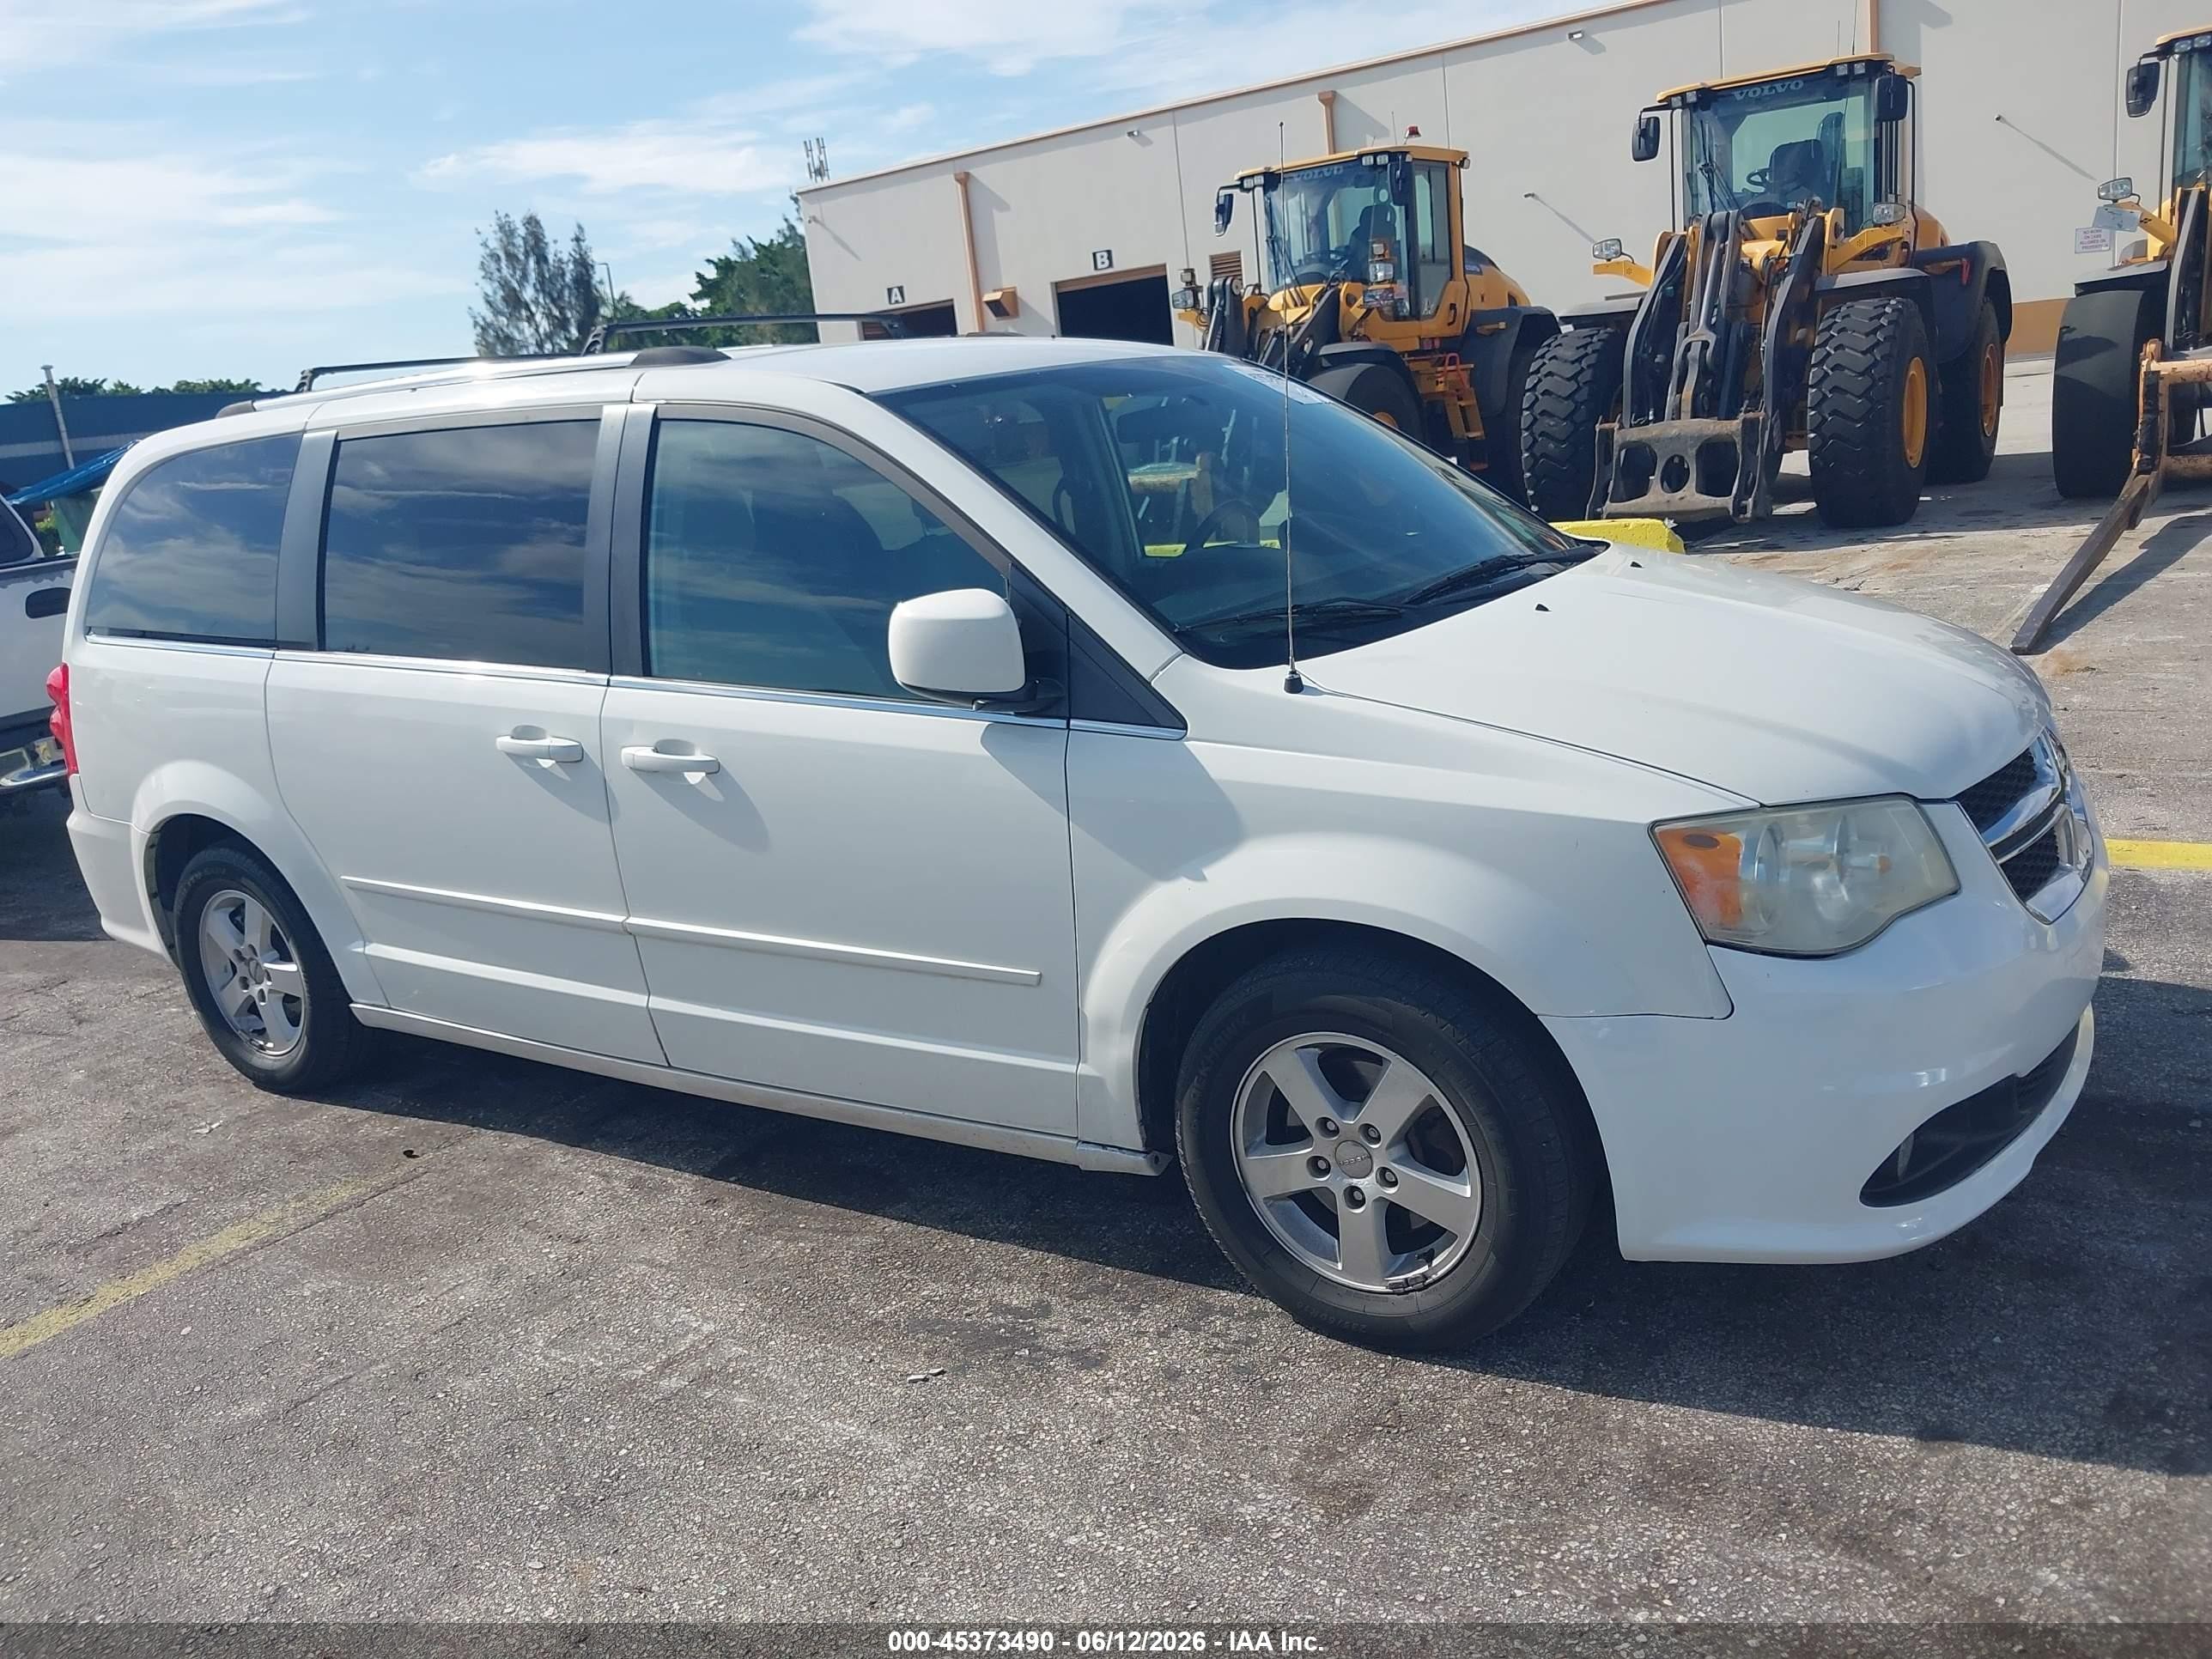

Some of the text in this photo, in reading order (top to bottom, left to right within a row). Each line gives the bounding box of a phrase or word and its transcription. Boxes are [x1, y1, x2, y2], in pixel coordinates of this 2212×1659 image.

[1732, 80, 1804, 100] VOLVO
[1097, 252, 1109, 269] B
[890, 288, 902, 304] A
